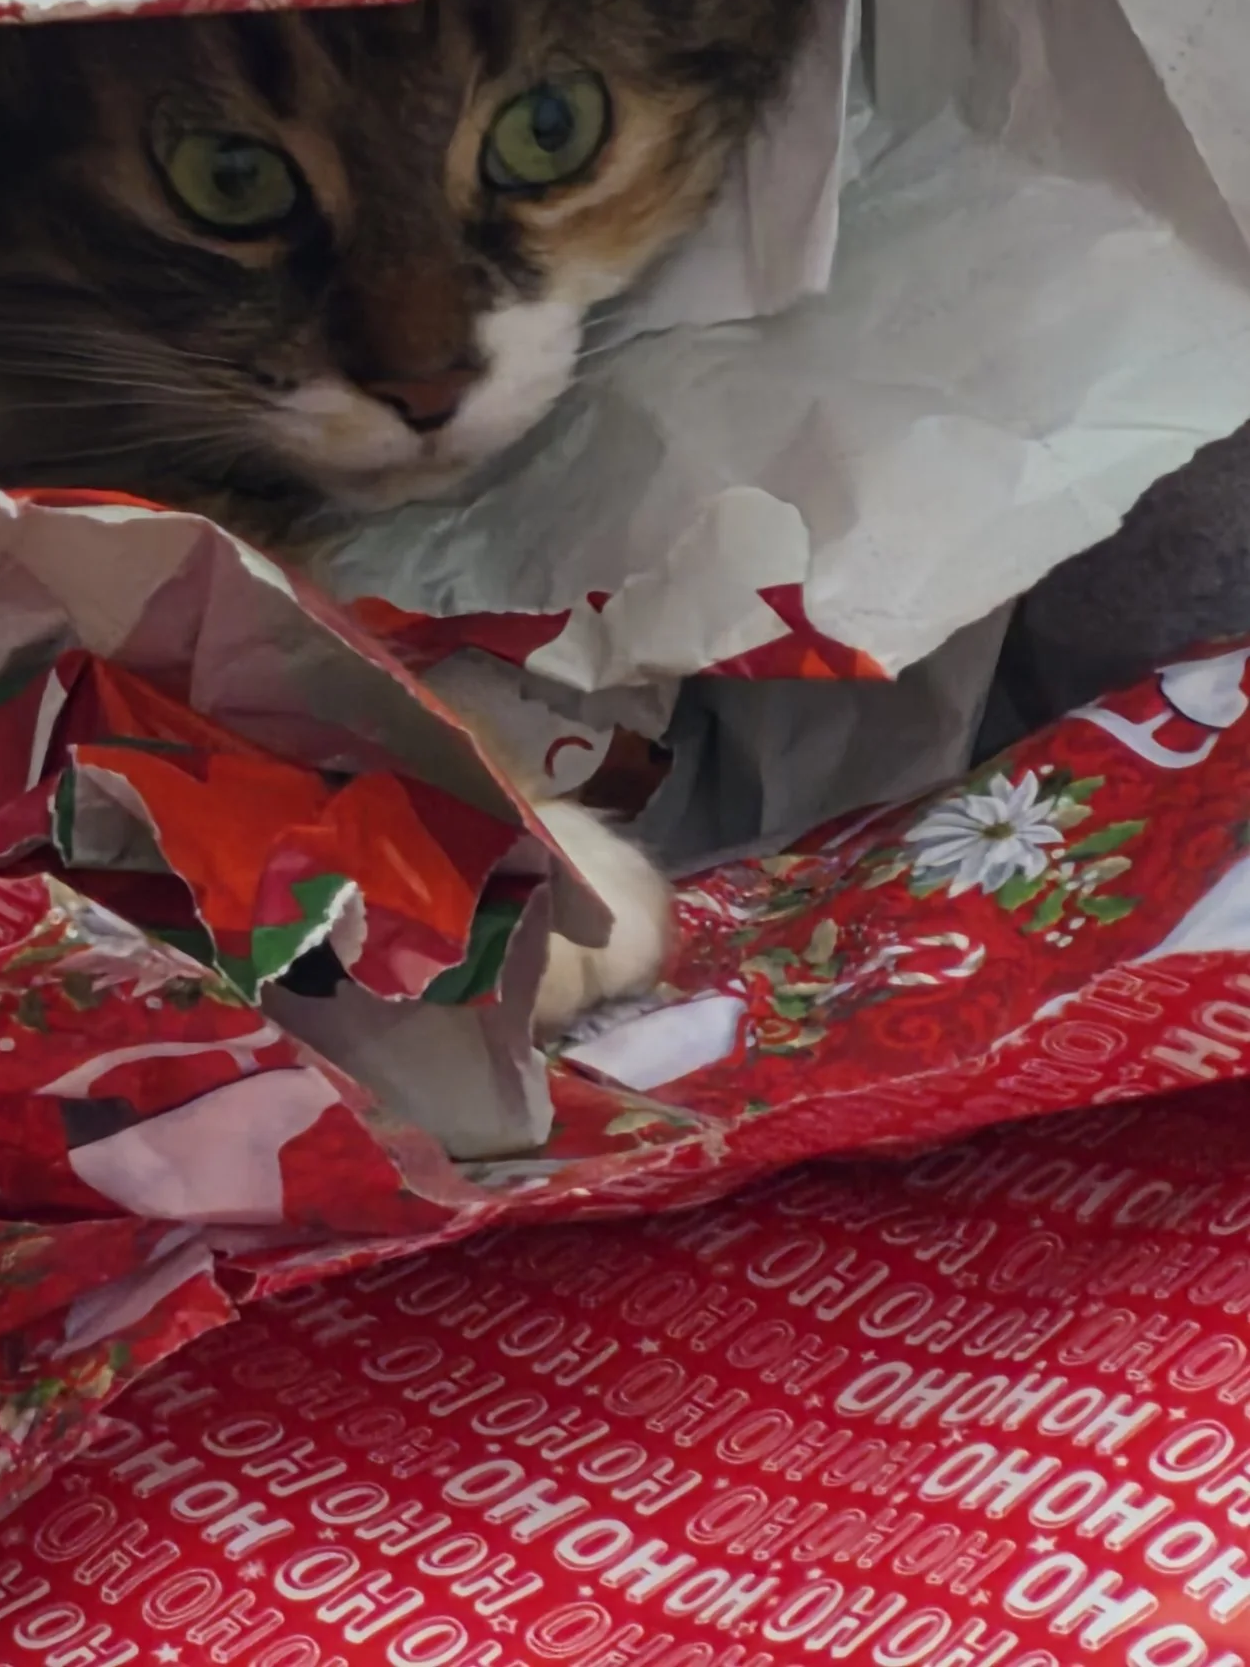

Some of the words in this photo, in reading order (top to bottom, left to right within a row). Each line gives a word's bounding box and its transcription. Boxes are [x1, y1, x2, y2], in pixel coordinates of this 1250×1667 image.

[362, 1336, 703, 1516] HOHOHO
[835, 1360, 1163, 1455] HOHOHO
[202, 1411, 543, 1616] HOHOHO
[441, 1458, 782, 1631] HOHOHO
